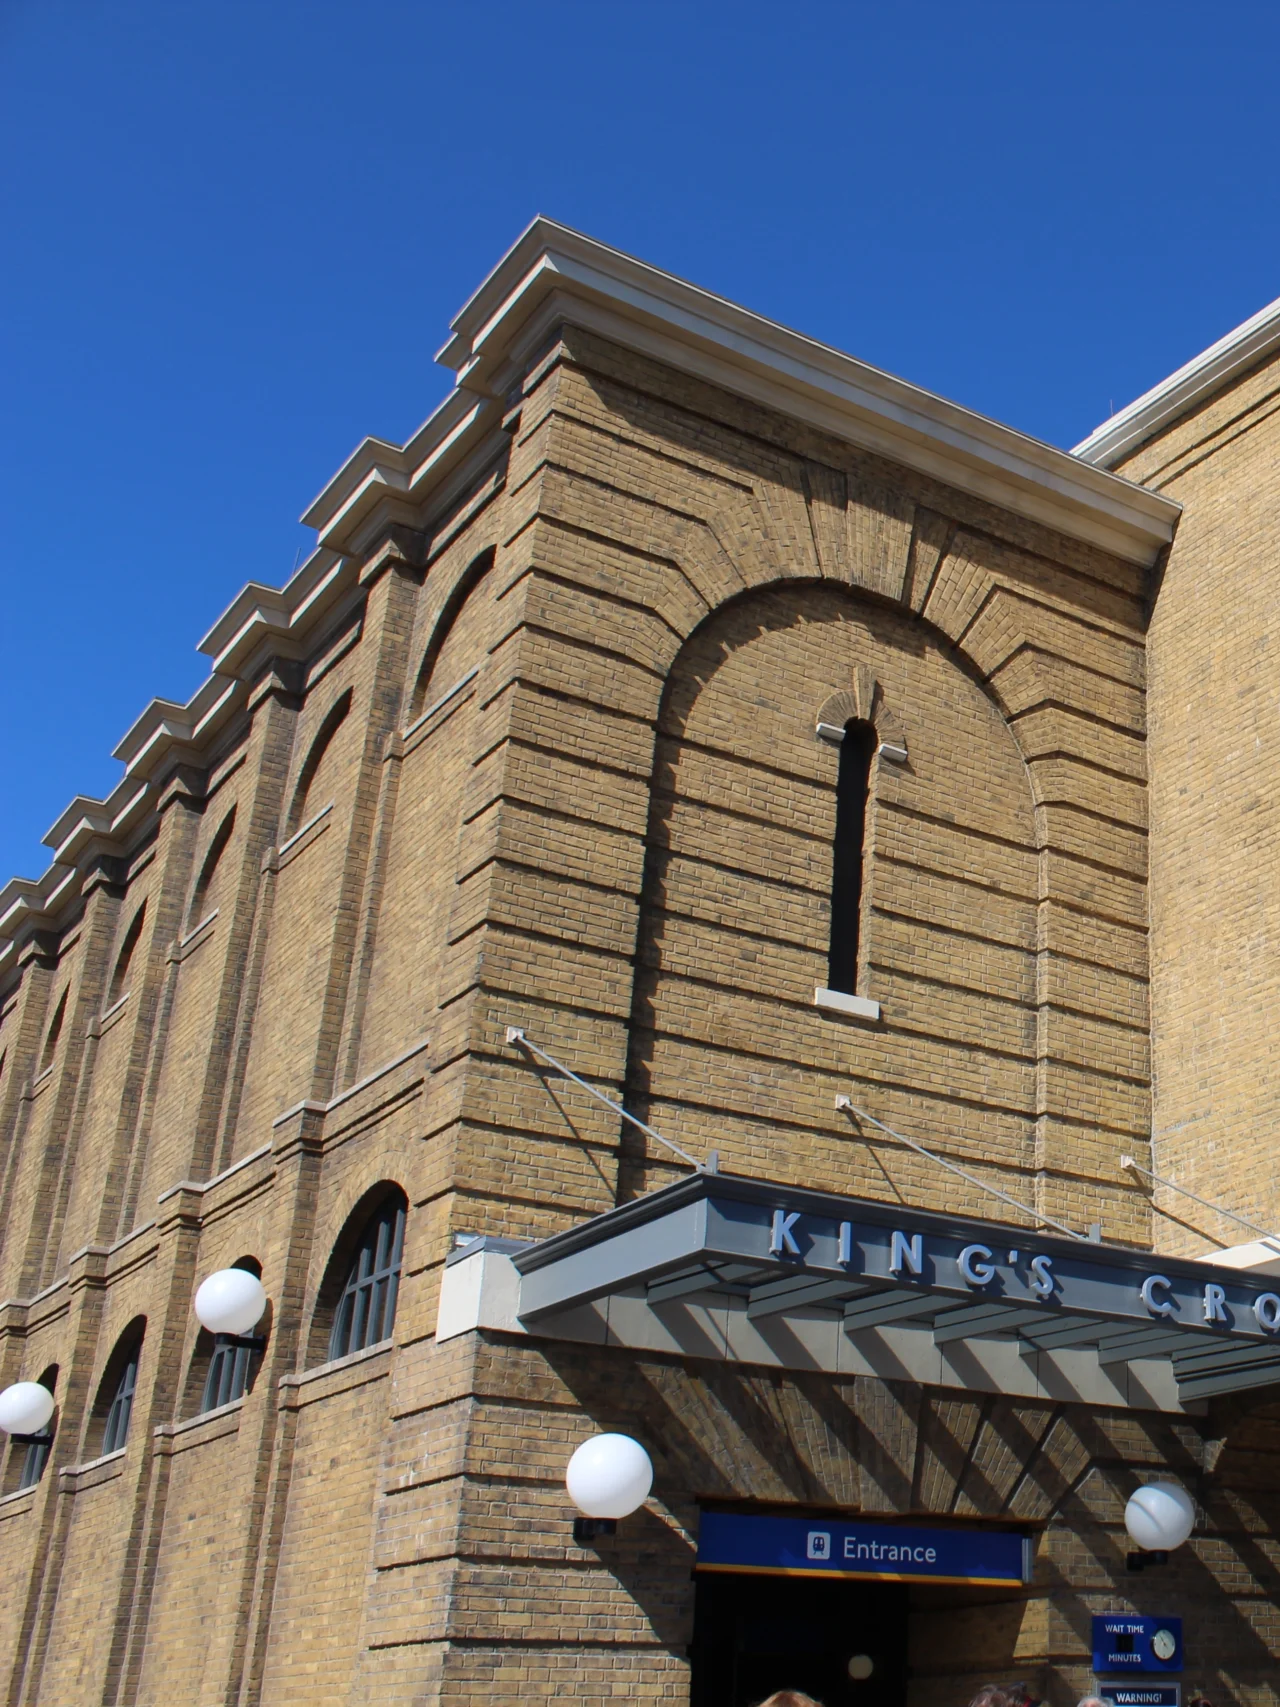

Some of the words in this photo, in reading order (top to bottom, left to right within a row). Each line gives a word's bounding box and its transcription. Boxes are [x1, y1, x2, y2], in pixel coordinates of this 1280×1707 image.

[769, 1209, 1054, 1297] KING'S
[843, 1536, 937, 1563] Entrance
[1105, 1624, 1125, 1634] WAIT
[1127, 1624, 1145, 1634] TIME
[1108, 1653, 1142, 1663] MINUTES
[1116, 1692, 1163, 1703] WARNING!
